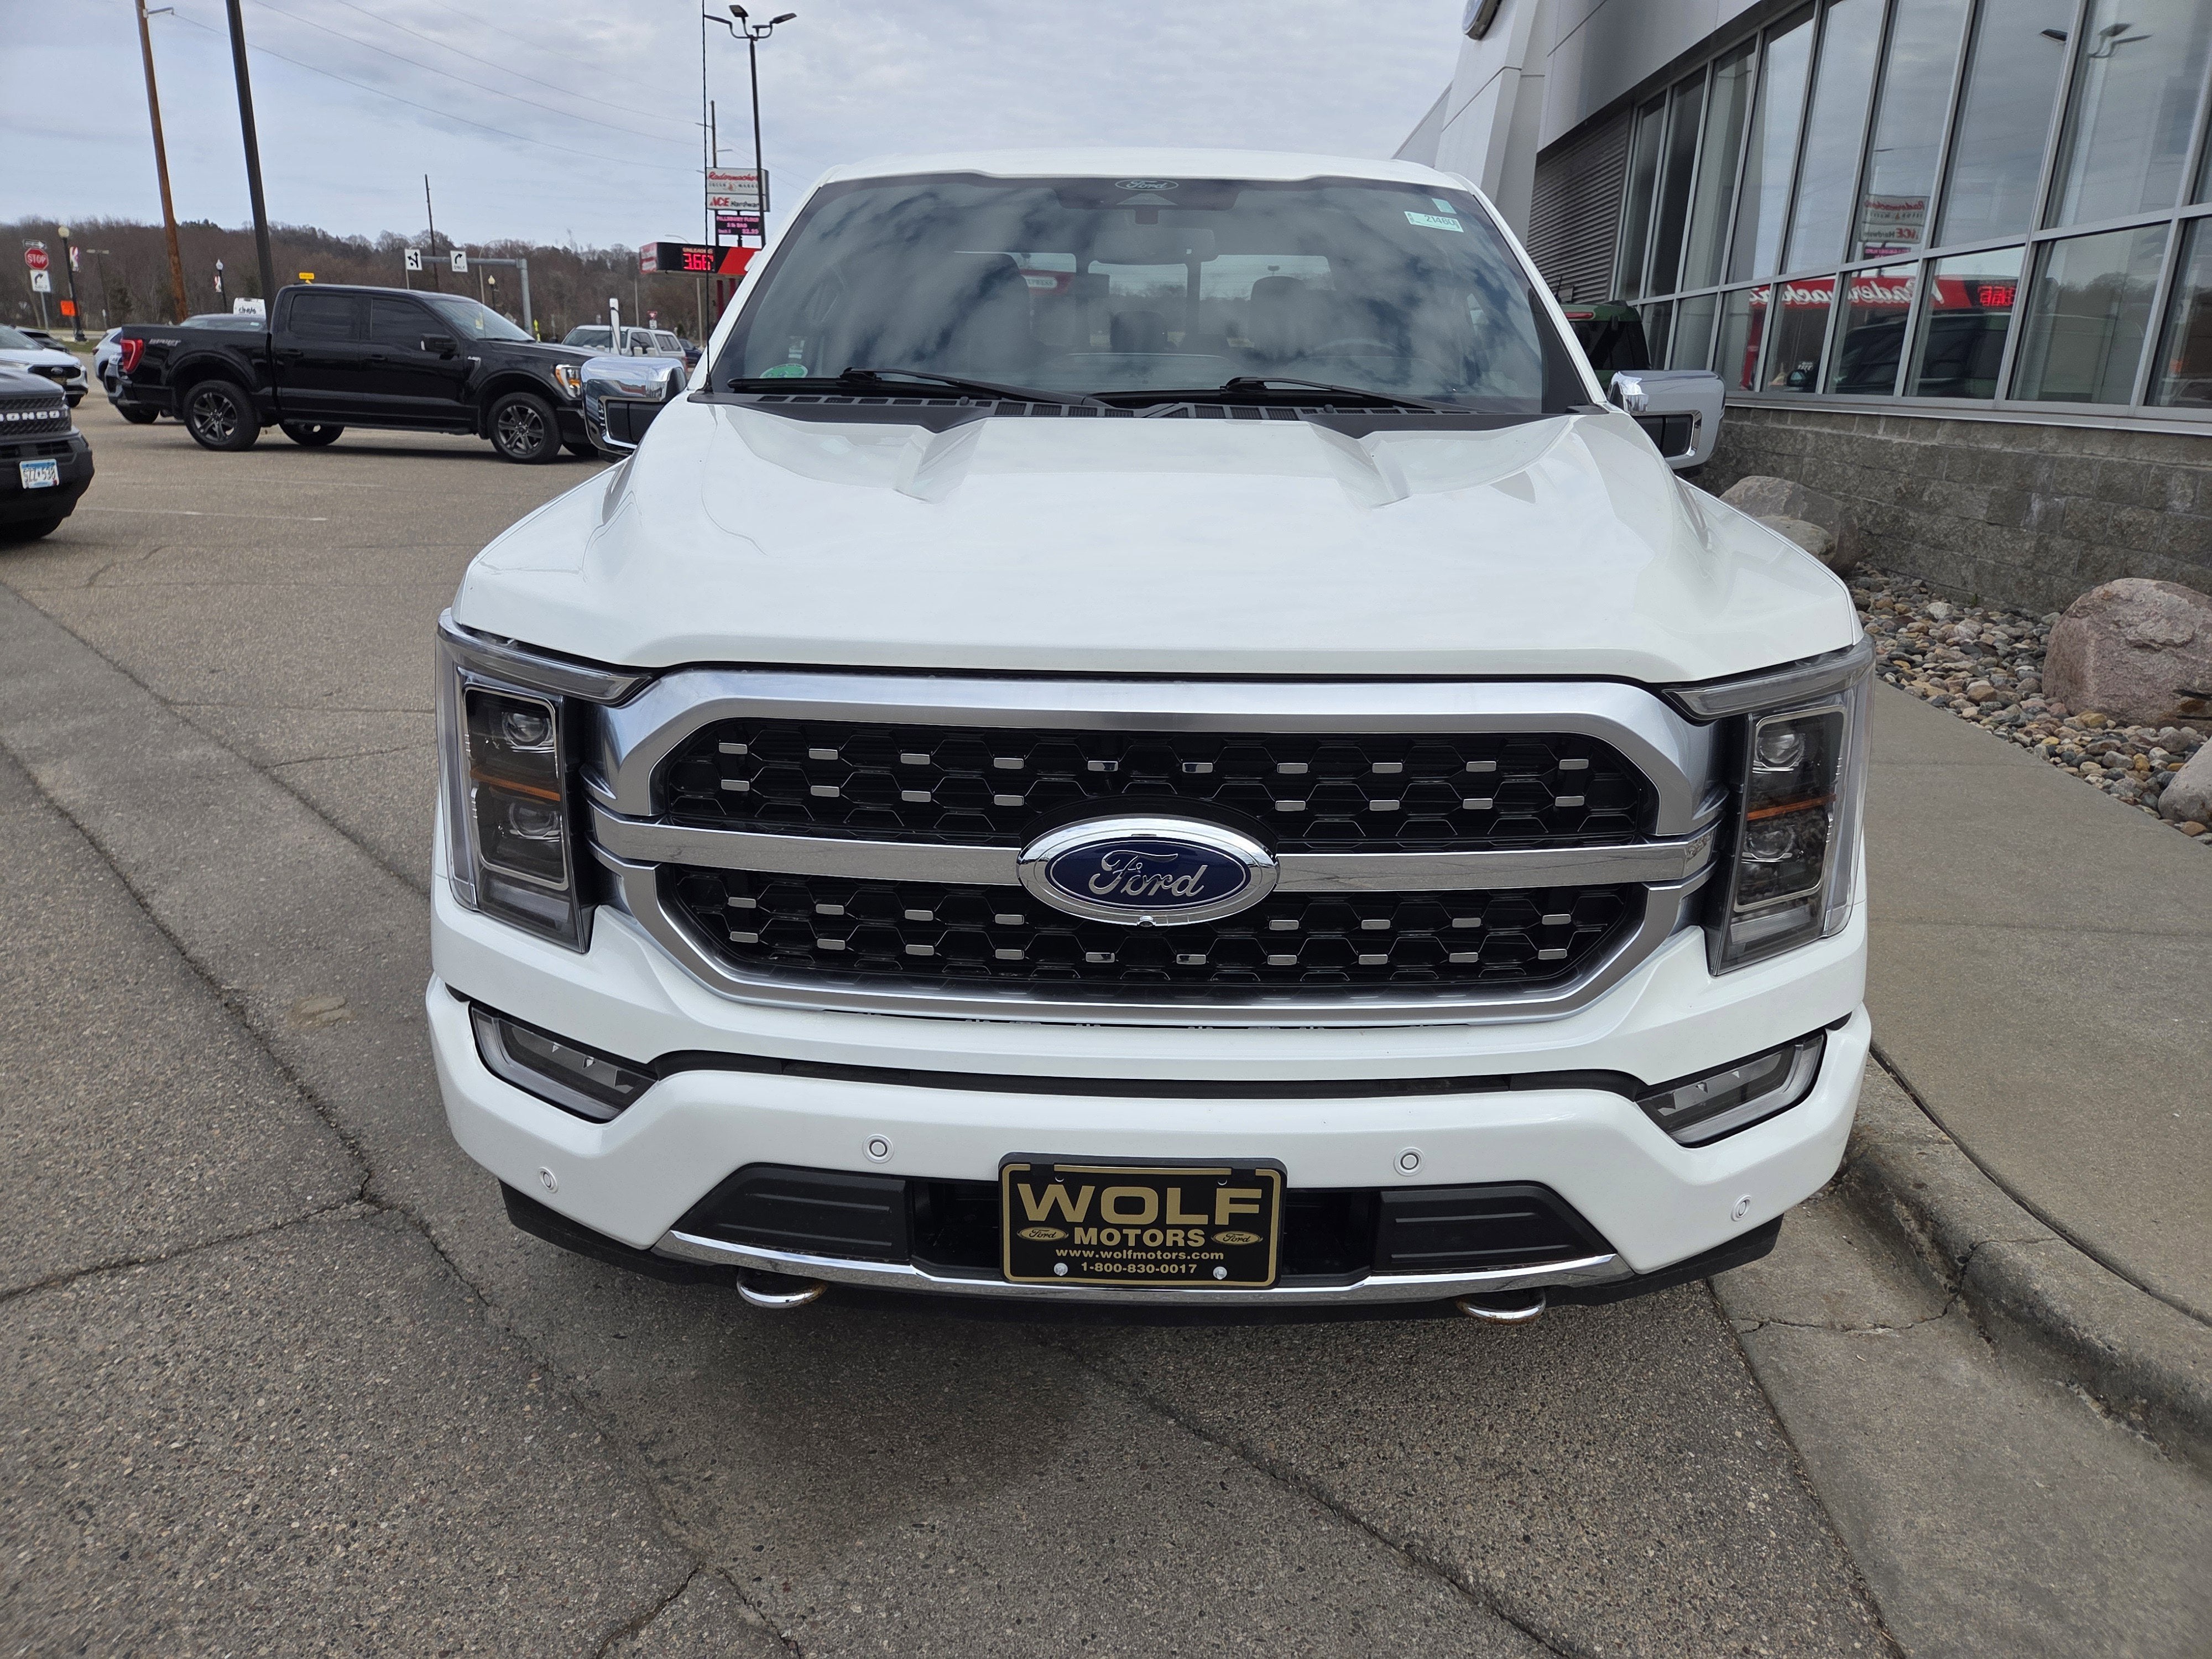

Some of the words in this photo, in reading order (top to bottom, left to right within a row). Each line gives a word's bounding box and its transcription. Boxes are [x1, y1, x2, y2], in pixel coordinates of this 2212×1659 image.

[1126, 180, 1168, 189] Ford
[27, 254, 46, 264] STOP
[0, 410, 60, 421] ONCO
[1088, 849, 1208, 897] Ford
[1017, 1183, 1262, 1225] WOLF
[1029, 1229, 1057, 1238] Ford
[1074, 1227, 1206, 1247] MOTORS
[1223, 1233, 1251, 1243] Ford
[1056, 1249, 1224, 1260] www.wolfmotors.com
[1081, 1261, 1197, 1274] 1-800-830-0017
